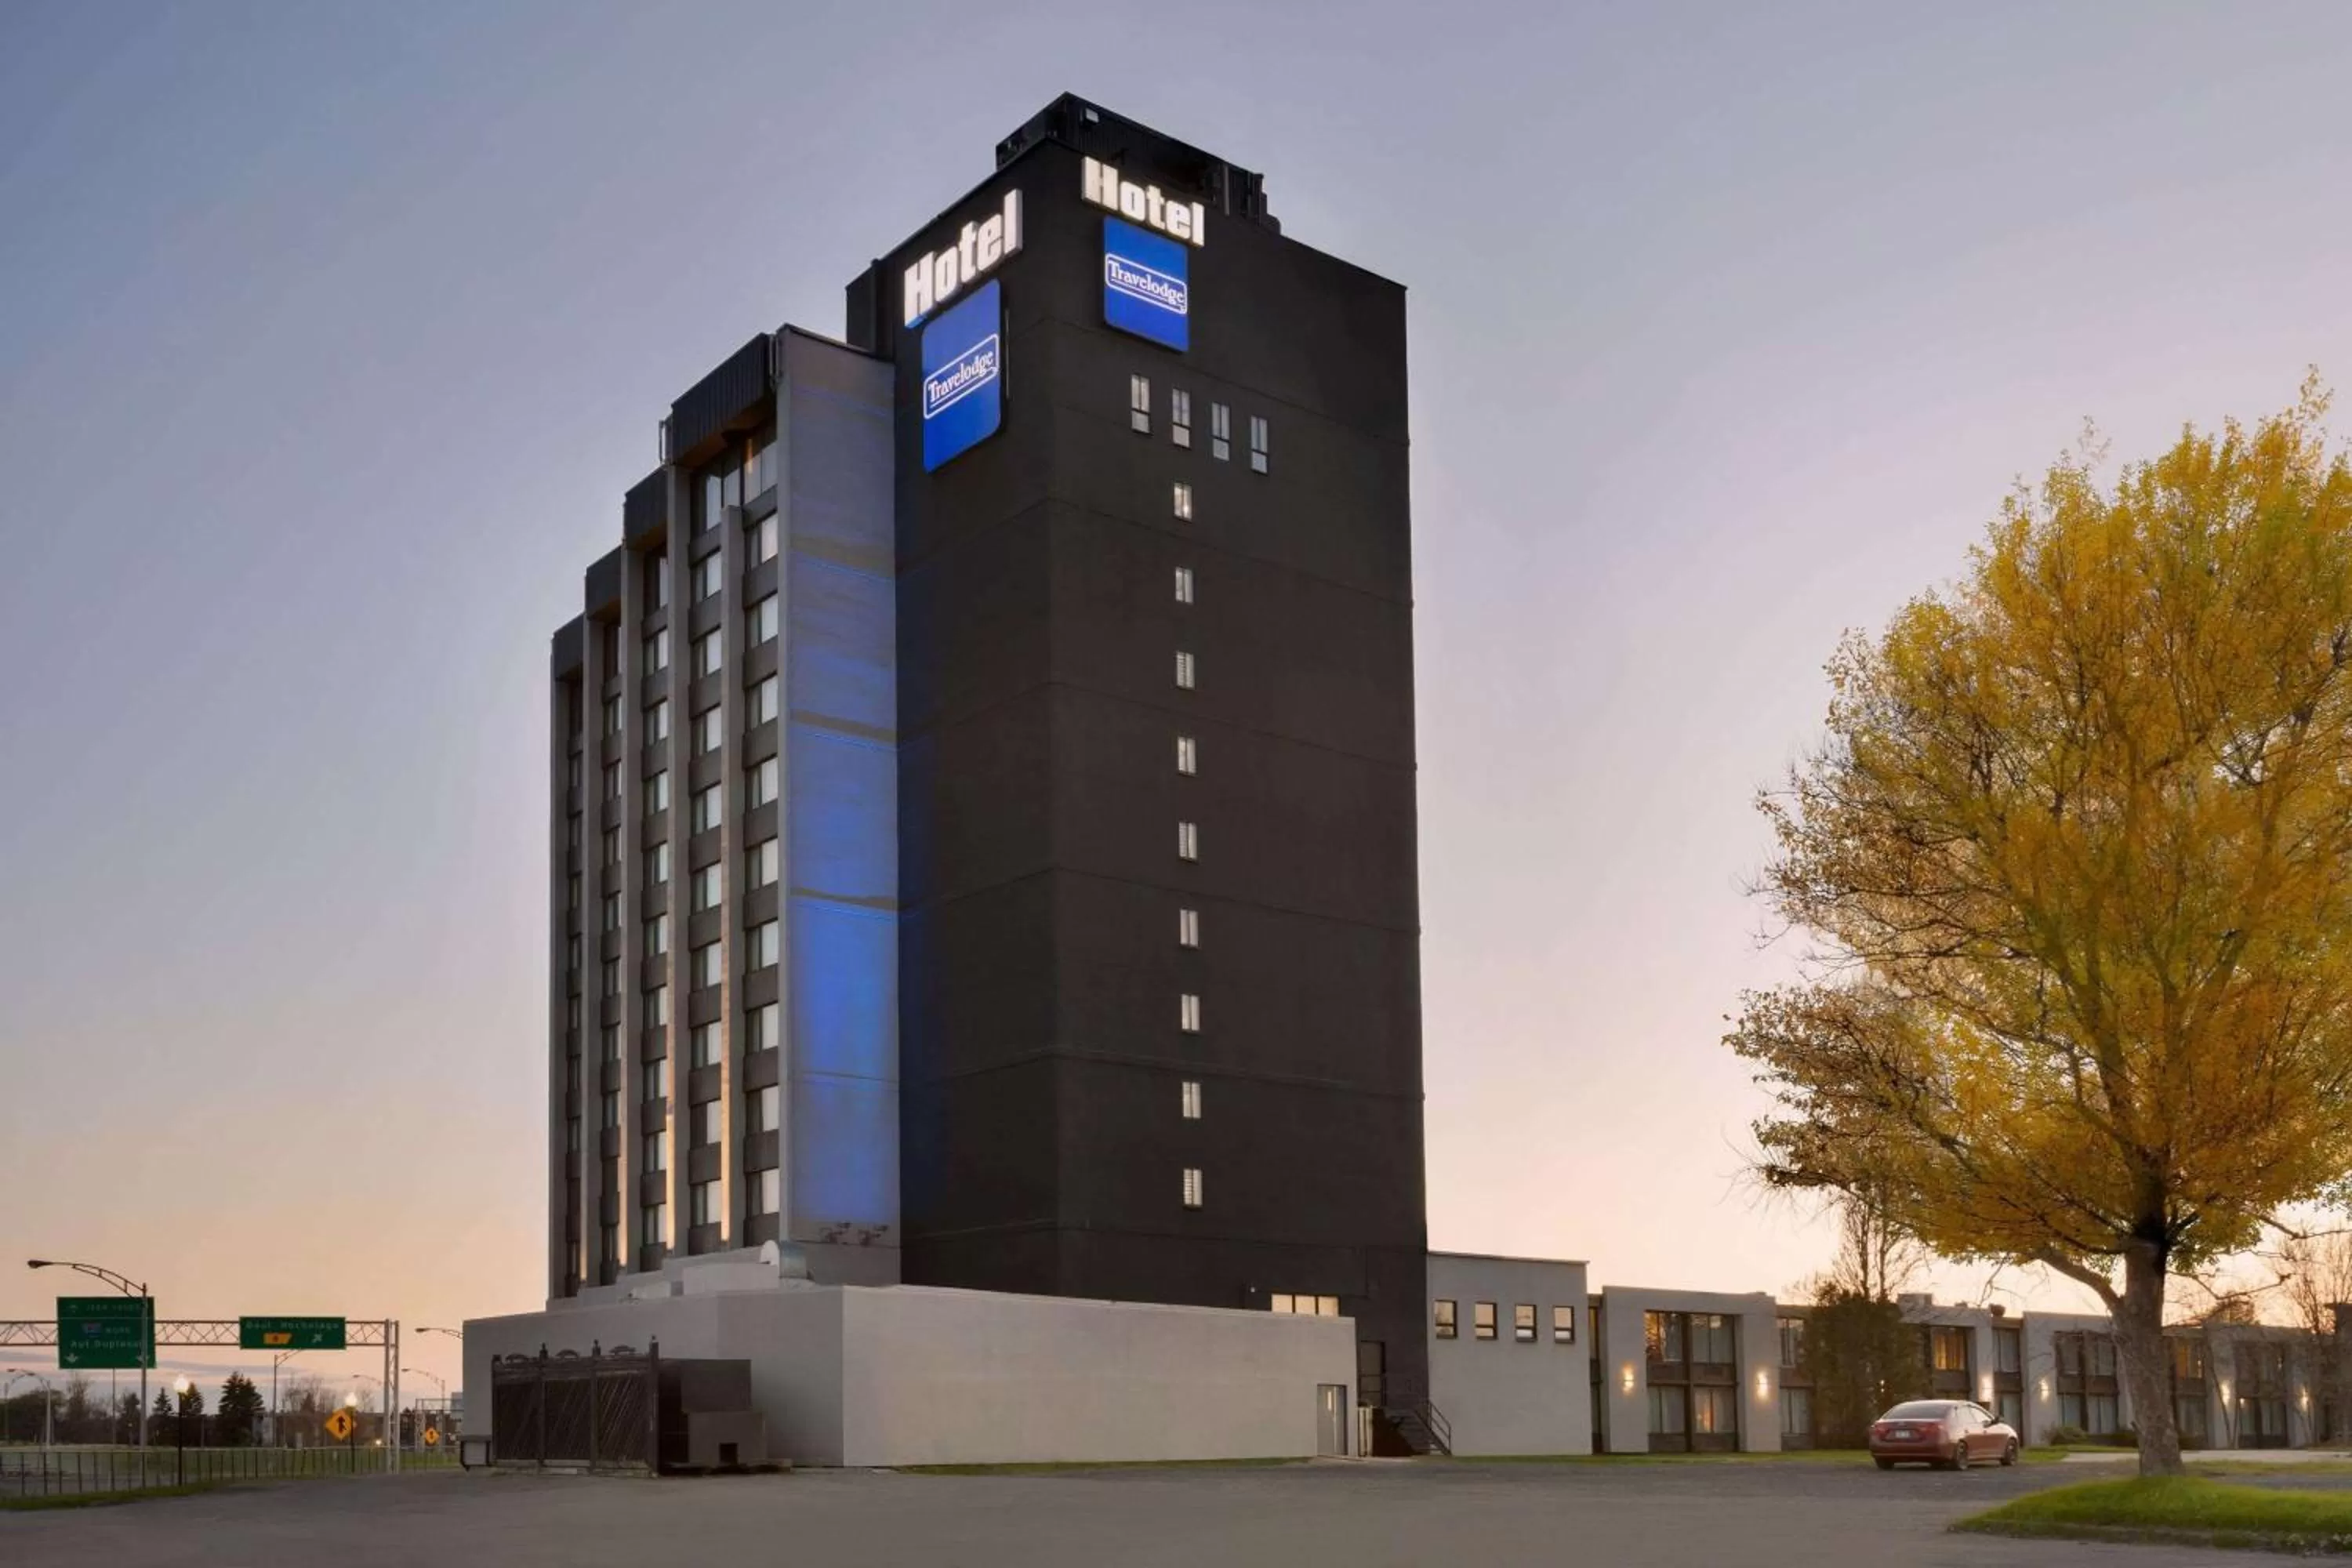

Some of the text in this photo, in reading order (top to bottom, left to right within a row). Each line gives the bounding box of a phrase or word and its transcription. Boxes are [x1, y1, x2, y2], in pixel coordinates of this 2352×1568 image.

[1081, 156, 1204, 248] Hotel
[905, 189, 1022, 328] Hotel
[1108, 260, 1185, 305] Travelodge
[927, 351, 993, 403] Travelodge
